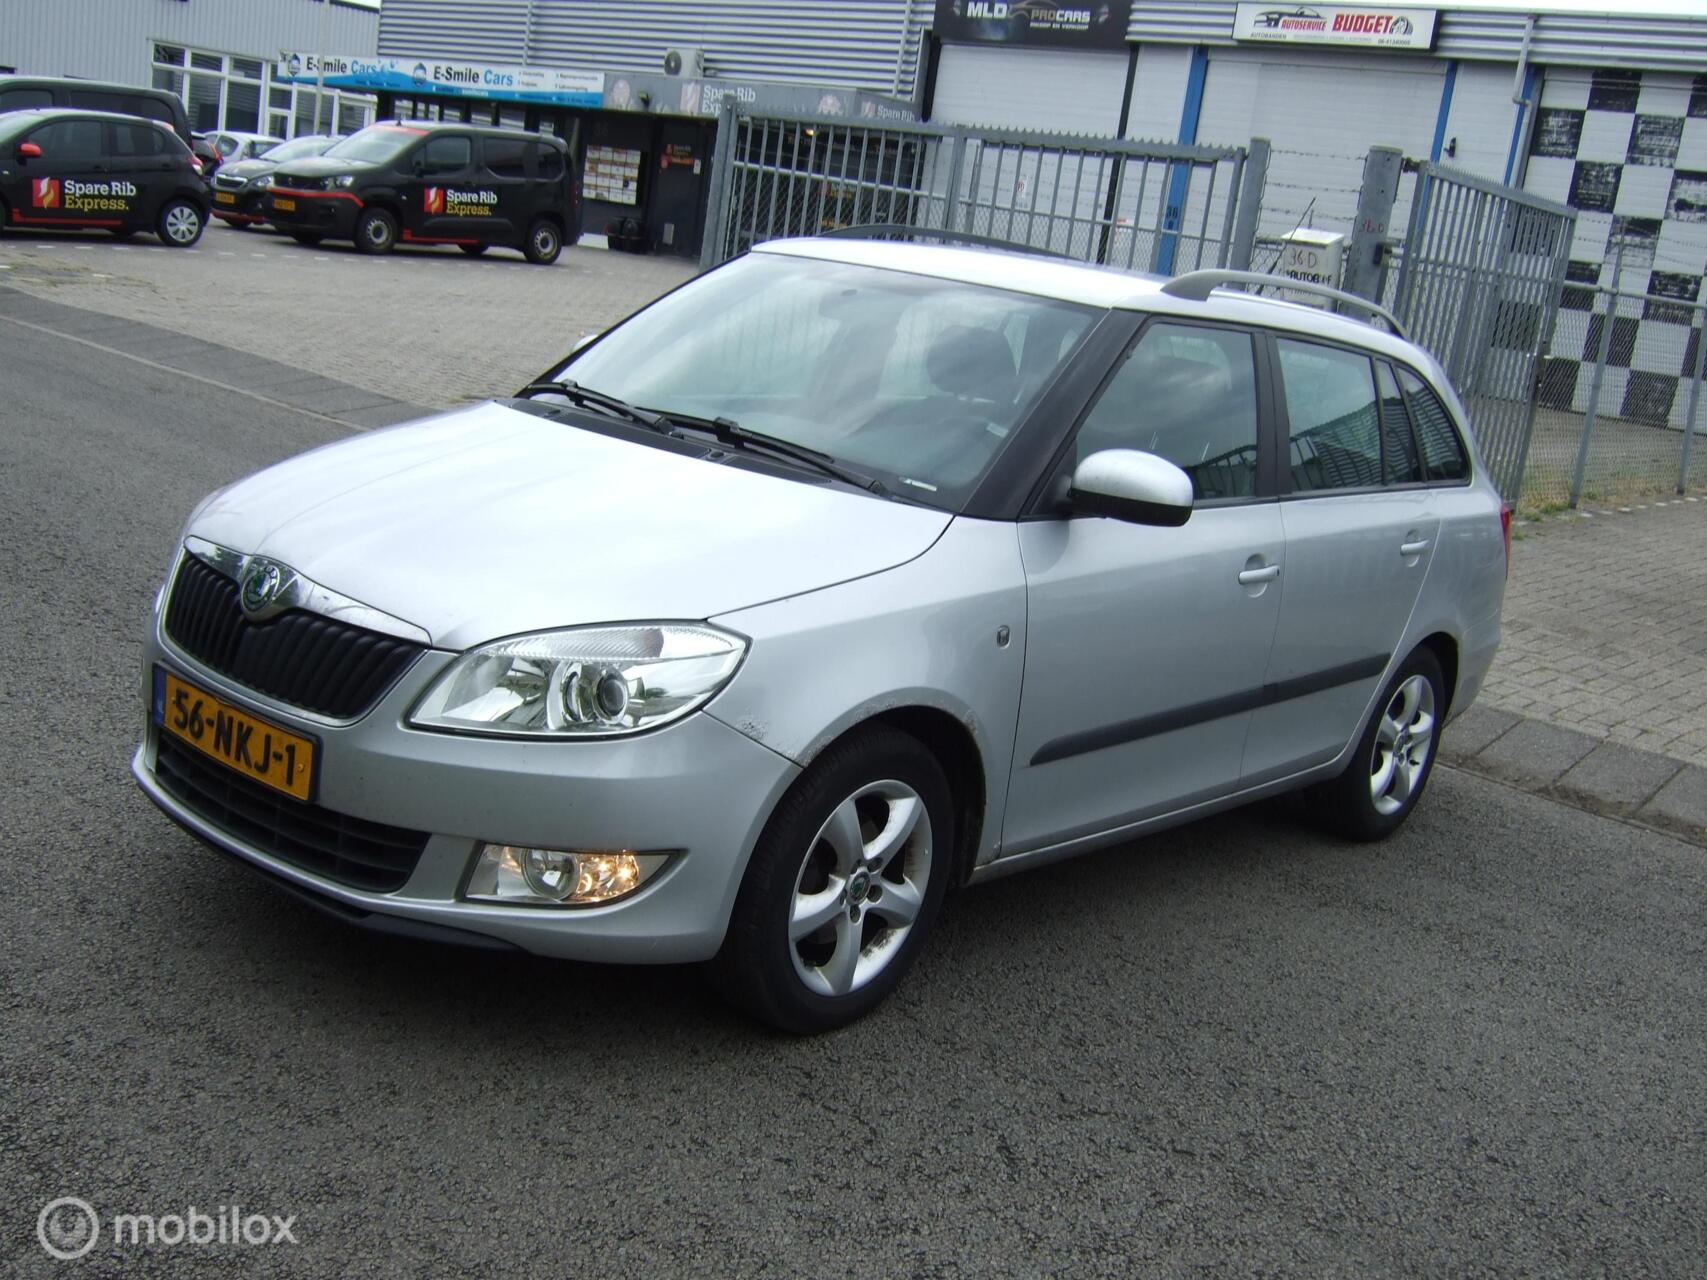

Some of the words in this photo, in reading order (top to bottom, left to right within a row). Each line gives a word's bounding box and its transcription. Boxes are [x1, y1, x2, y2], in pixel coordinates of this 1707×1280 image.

[966, 1, 1008, 19] MLD
[1031, 9, 1090, 22] PROCARS
[1281, 18, 1327, 32] AUTOSERVICE
[1332, 15, 1393, 33] BUDGET
[433, 65, 480, 83] E-Smile
[483, 68, 514, 88] Cars
[737, 88, 756, 106] Rib
[64, 180, 109, 196] Spare
[111, 181, 136, 196] Rib
[64, 195, 129, 212] Express.
[446, 189, 479, 204] Spare
[480, 191, 498, 205] Rib
[446, 202, 492, 217] Express.
[173, 688, 296, 787] 56-NKJ-1
